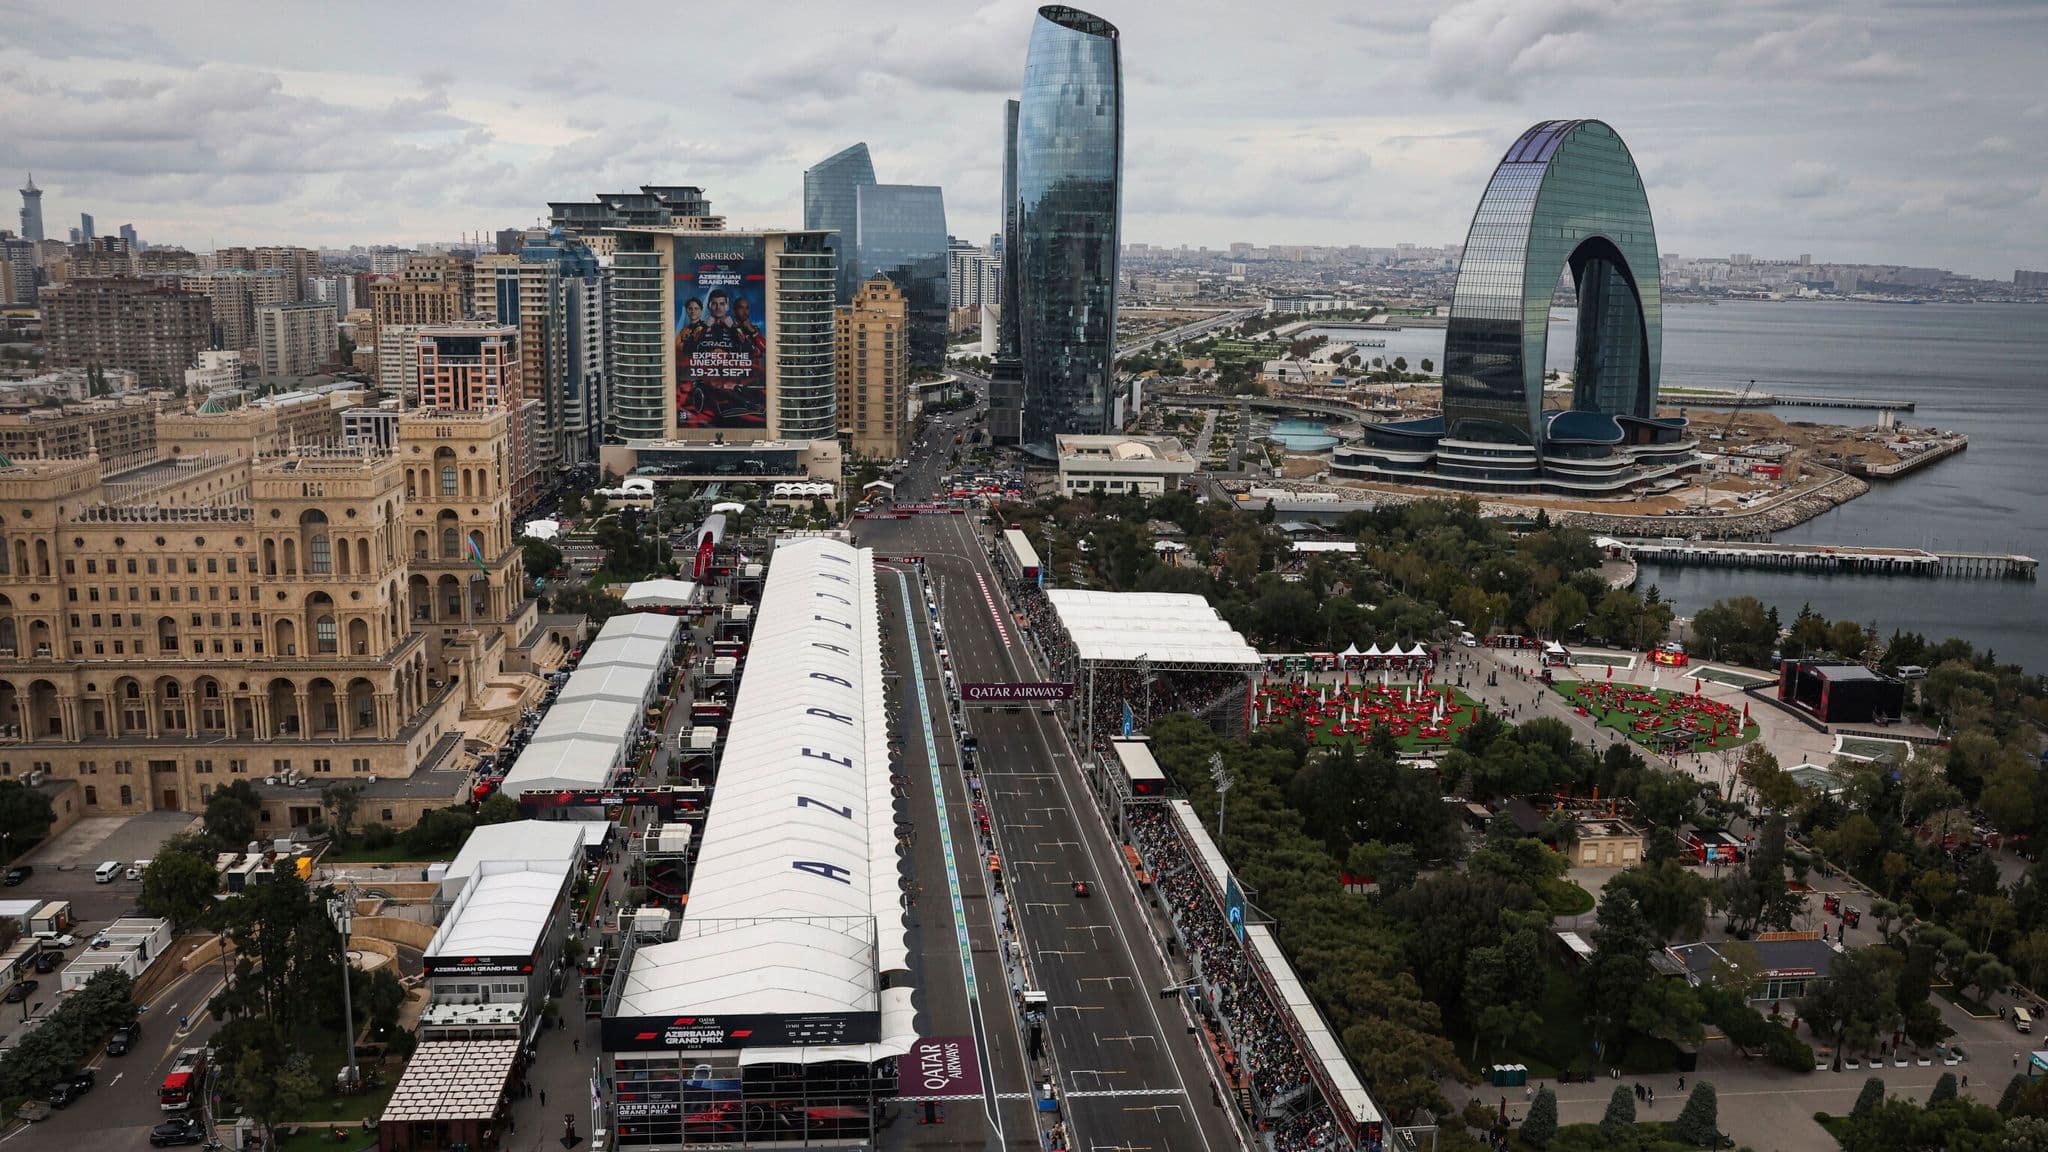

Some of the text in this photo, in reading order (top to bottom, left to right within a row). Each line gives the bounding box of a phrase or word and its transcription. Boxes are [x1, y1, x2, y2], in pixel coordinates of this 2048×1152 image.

[694, 252, 744, 260] ABSHERON
[692, 352, 749, 360] EXPECT THE
[689, 359, 752, 367] UNEXPECTED
[690, 368, 752, 377] 19-21 SEPT
[970, 687, 1064, 699] QATAR AIRWAYS
[793, 554, 853, 885] AZERBAIJAN
[664, 1030, 725, 1038] AZERBAIJAN
[945, 1043, 963, 1079] AIRWAYS
[920, 1044, 949, 1090] QATAR
